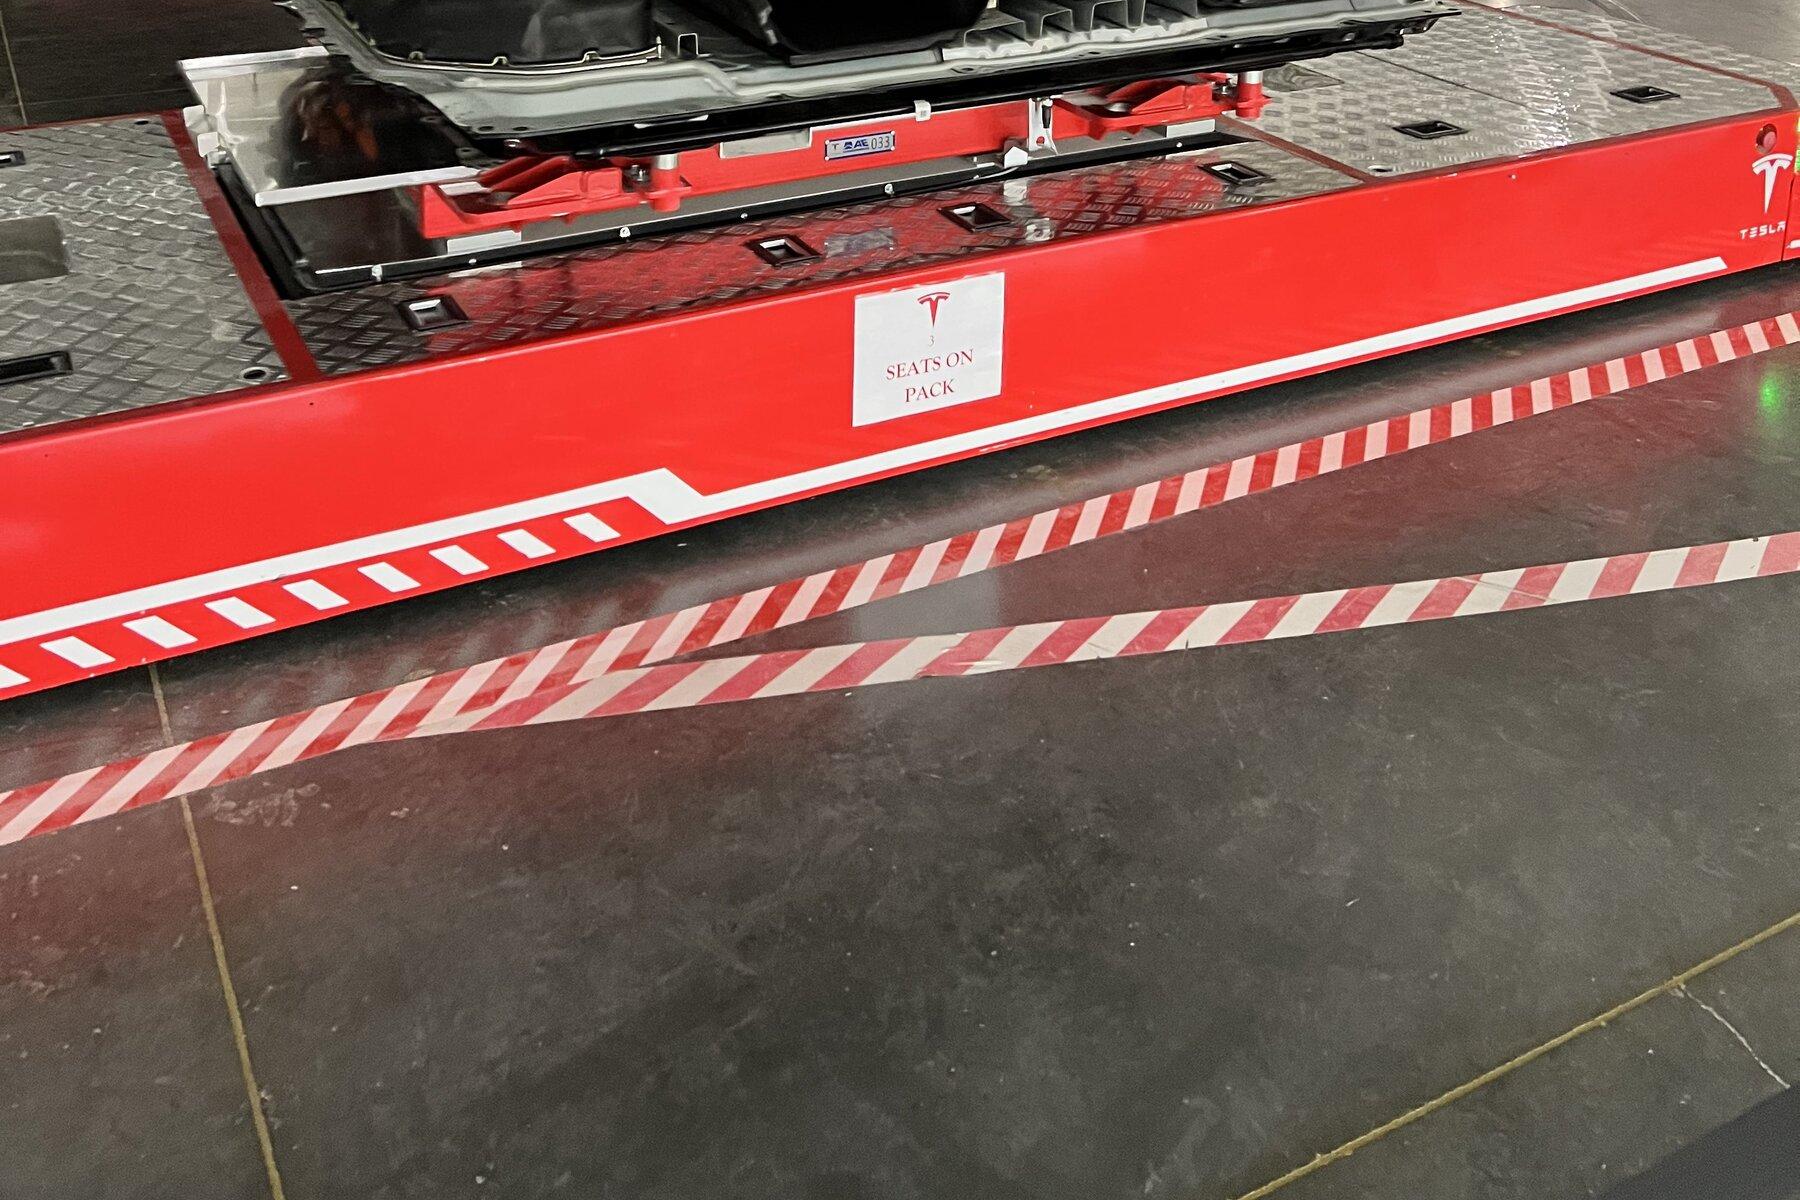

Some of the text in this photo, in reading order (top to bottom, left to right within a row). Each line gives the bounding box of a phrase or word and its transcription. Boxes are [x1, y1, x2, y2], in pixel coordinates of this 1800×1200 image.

[870, 135, 890, 150] 033
[1739, 221, 1786, 240] TESLA
[885, 349, 974, 381] SEATS ON
[904, 378, 956, 403] PACK
